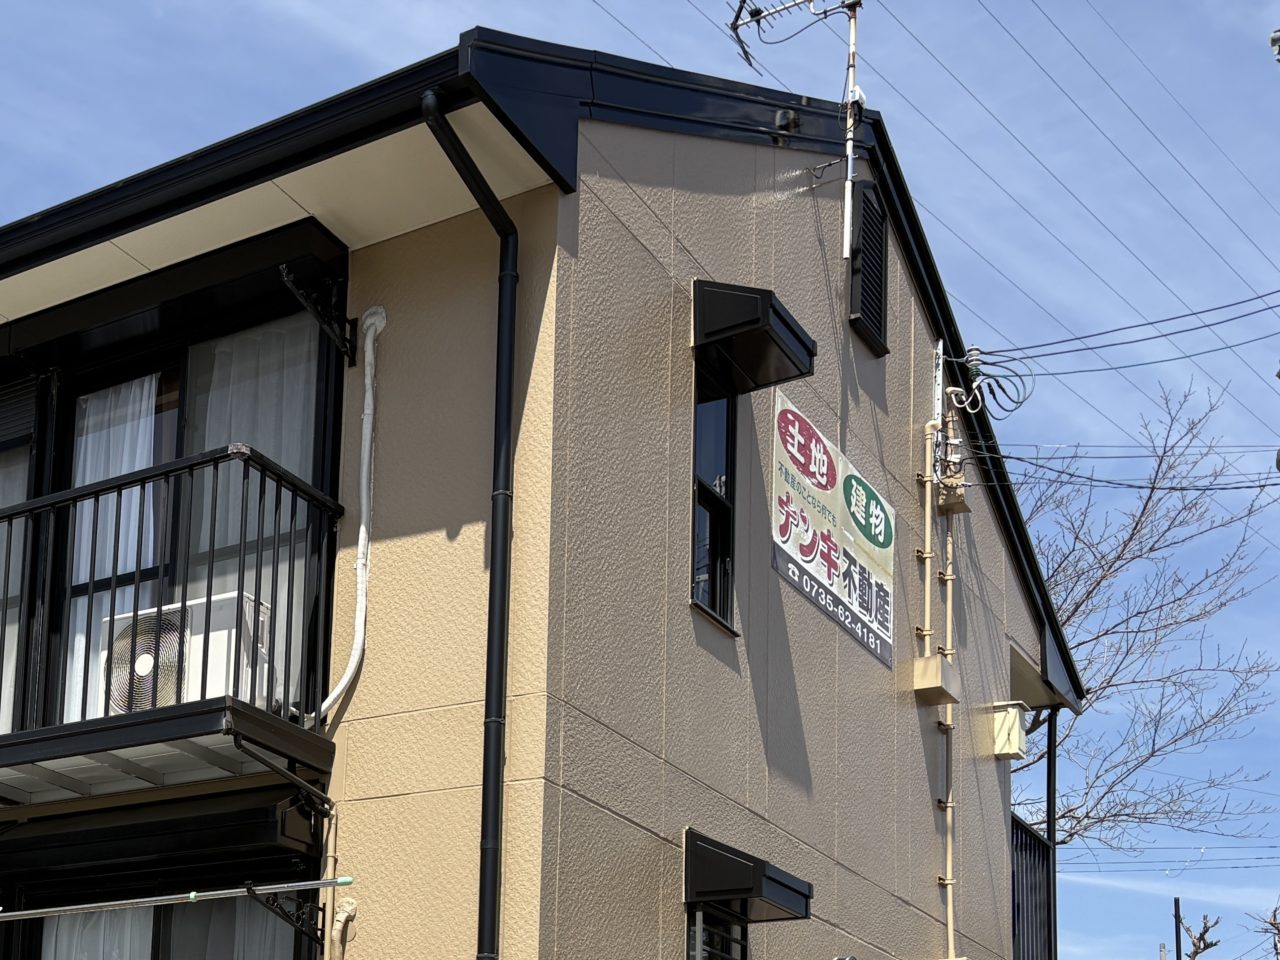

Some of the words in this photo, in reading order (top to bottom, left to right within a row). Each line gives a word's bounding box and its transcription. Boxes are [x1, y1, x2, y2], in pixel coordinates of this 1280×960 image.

[786, 419, 828, 487] 土地
[850, 478, 885, 544] 建物
[777, 491, 891, 640] ナンキ不動産
[802, 575, 881, 654] 0735-62-4181
